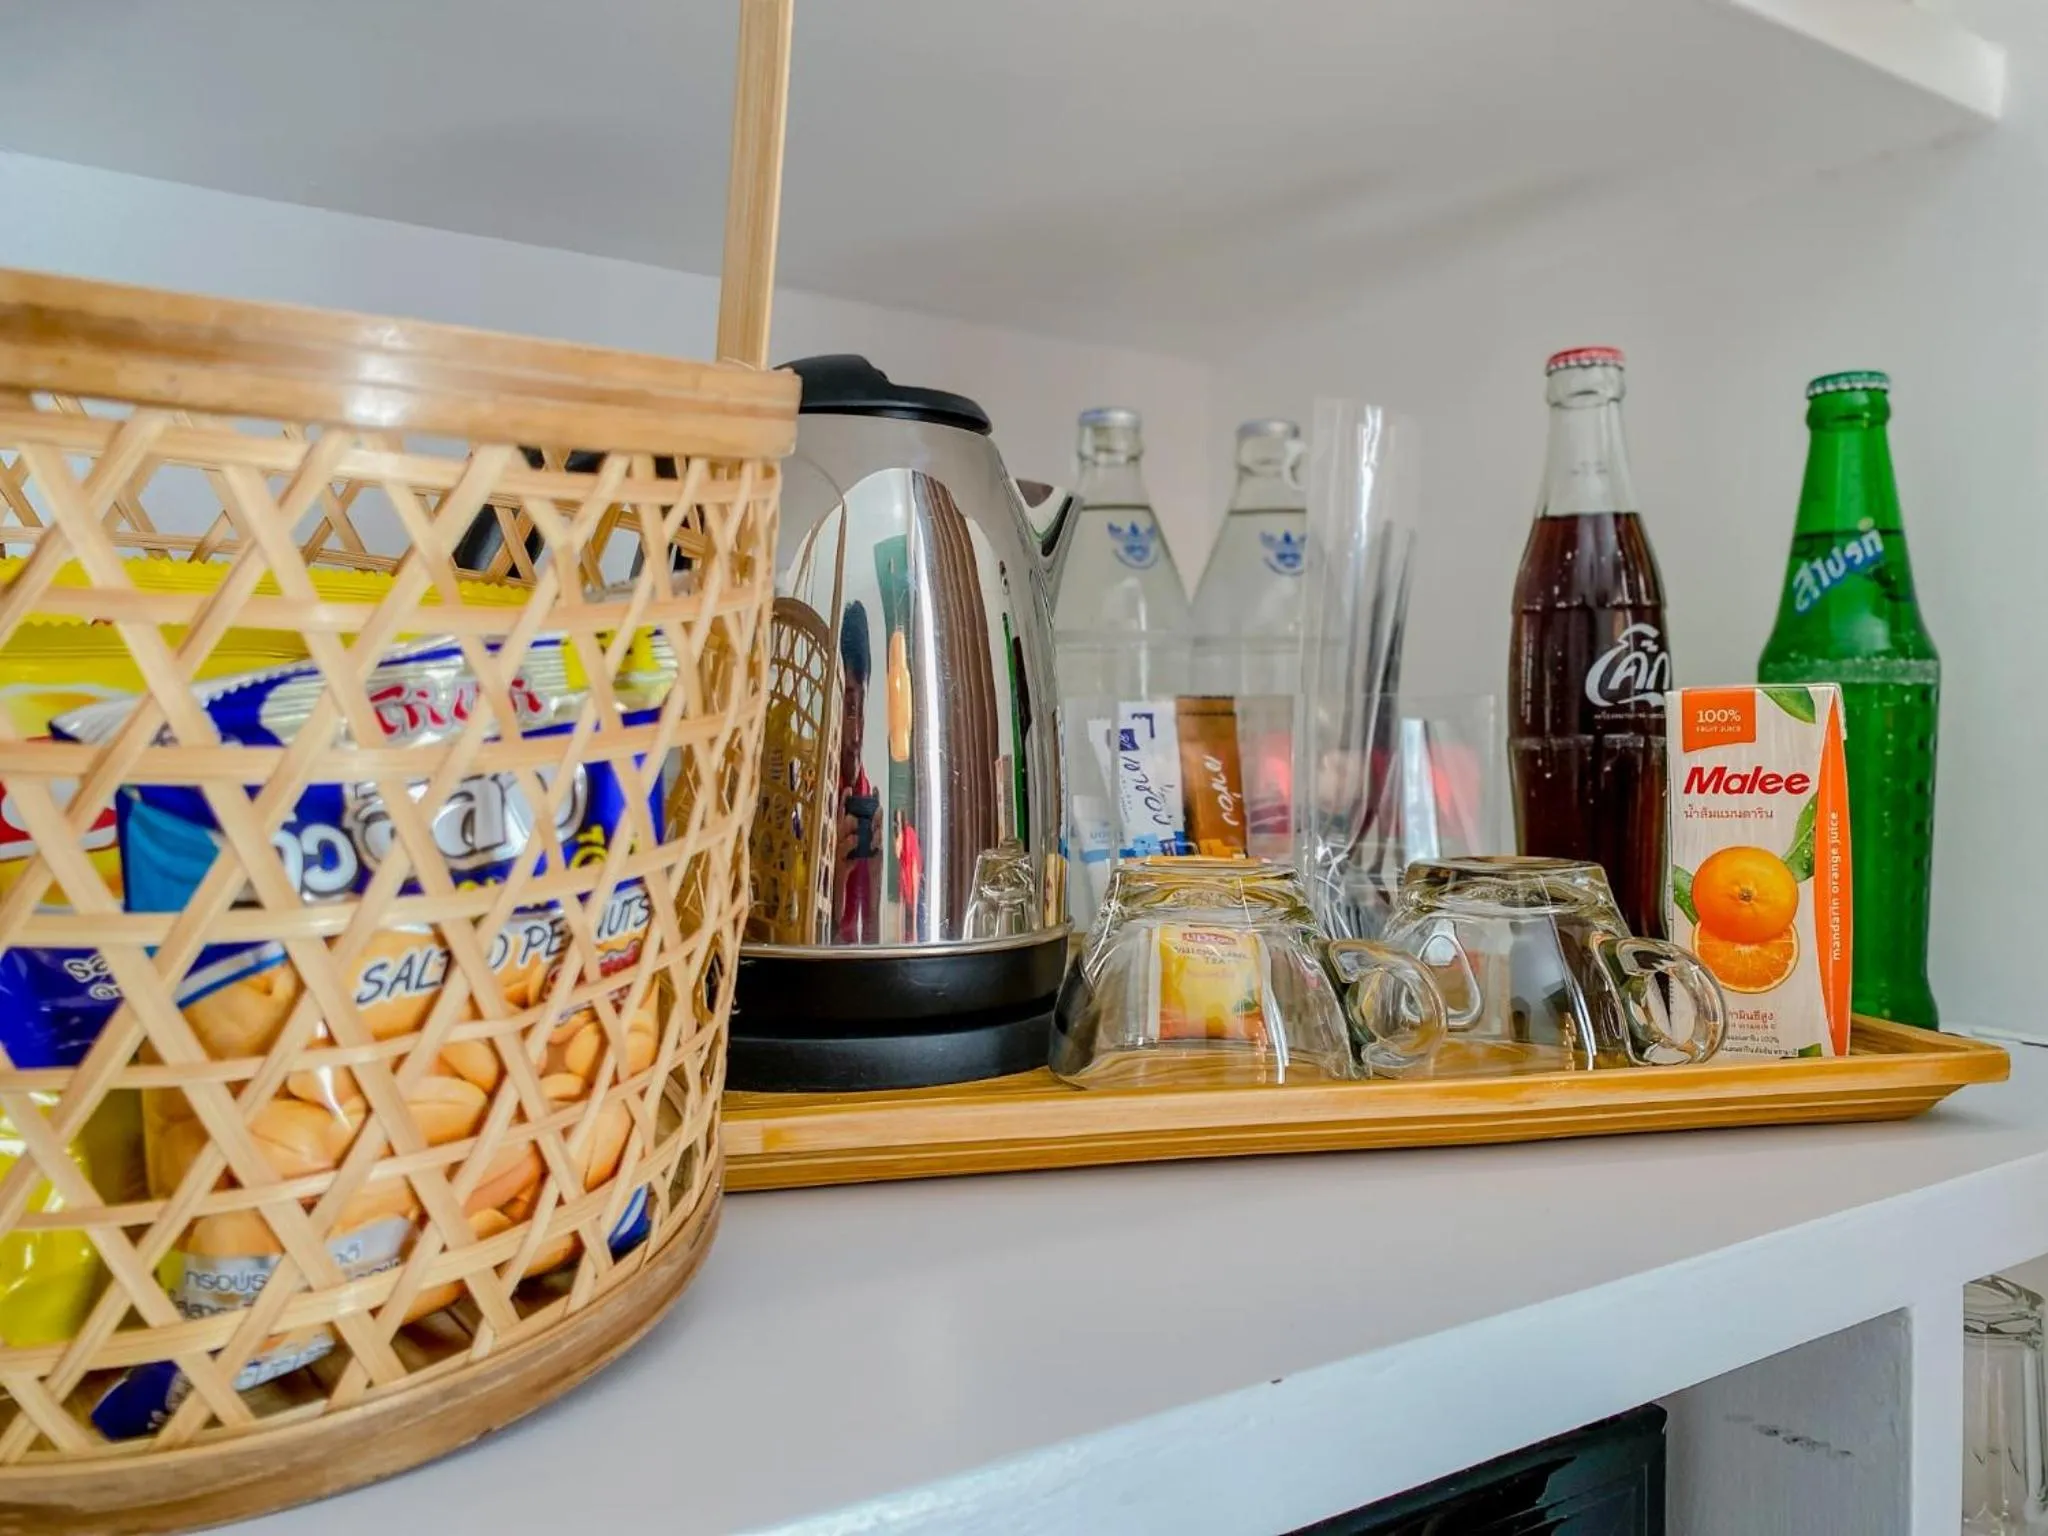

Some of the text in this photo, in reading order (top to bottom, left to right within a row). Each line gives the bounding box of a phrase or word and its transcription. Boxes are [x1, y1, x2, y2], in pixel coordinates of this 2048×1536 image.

[1696, 709, 1742, 723] 100%
[1683, 765, 1811, 795] Malee
[1829, 811, 1842, 961] mandarin orange juice
